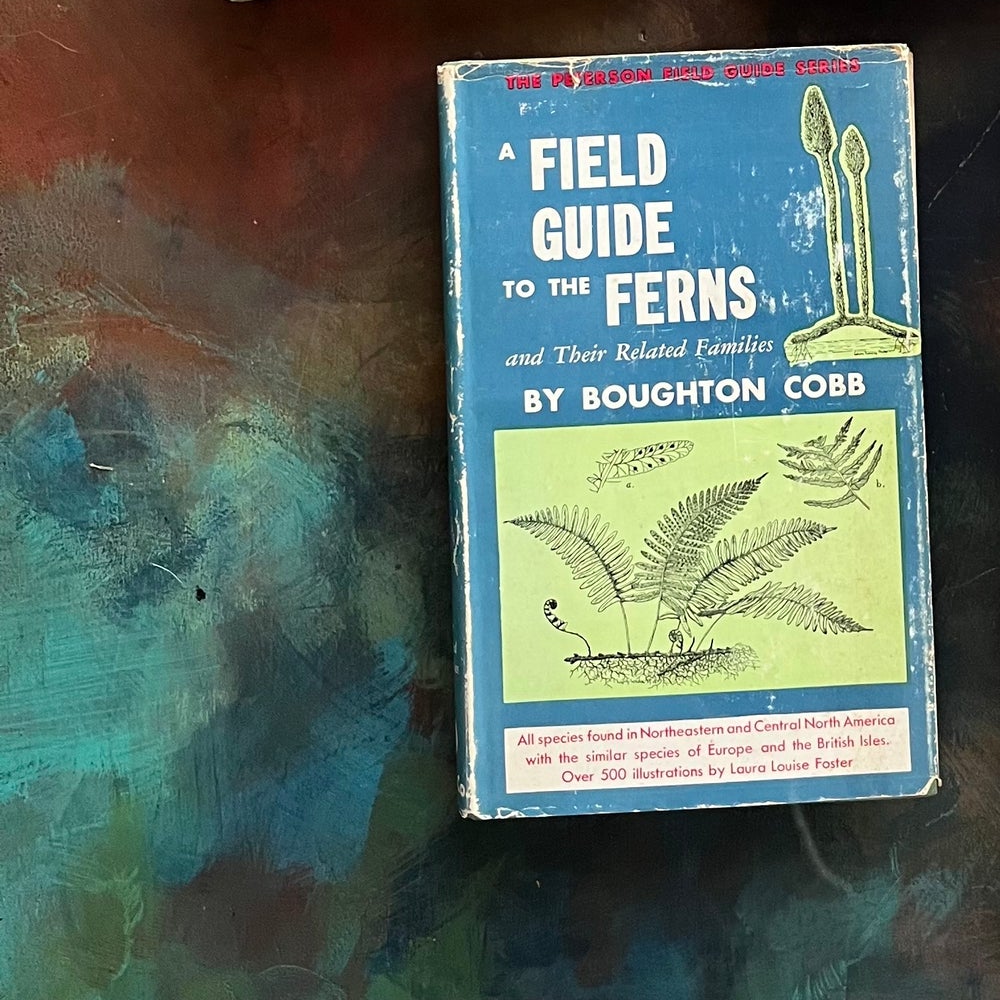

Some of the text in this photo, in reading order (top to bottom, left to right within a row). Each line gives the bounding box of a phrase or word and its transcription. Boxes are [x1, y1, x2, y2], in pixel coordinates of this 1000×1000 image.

[506, 73, 541, 90] THE
[662, 64, 714, 84] FIELD
[724, 62, 785, 79] GUIDE
[795, 58, 861, 76] SERIES
[499, 133, 666, 192] A FIELD
[532, 201, 675, 261] GUIDE
[503, 266, 757, 327] TO THE FERNS
[506, 336, 774, 367] and Their Related Families
[524, 372, 866, 413] BY BOUGHTON COBB
[517, 714, 895, 747] All species found in Northeastern and Central North America
[525, 733, 889, 765] with the similar species of Europe and the British Isles.
[561, 757, 853, 783] Over 500 illustrations by Laura Louise Foster
